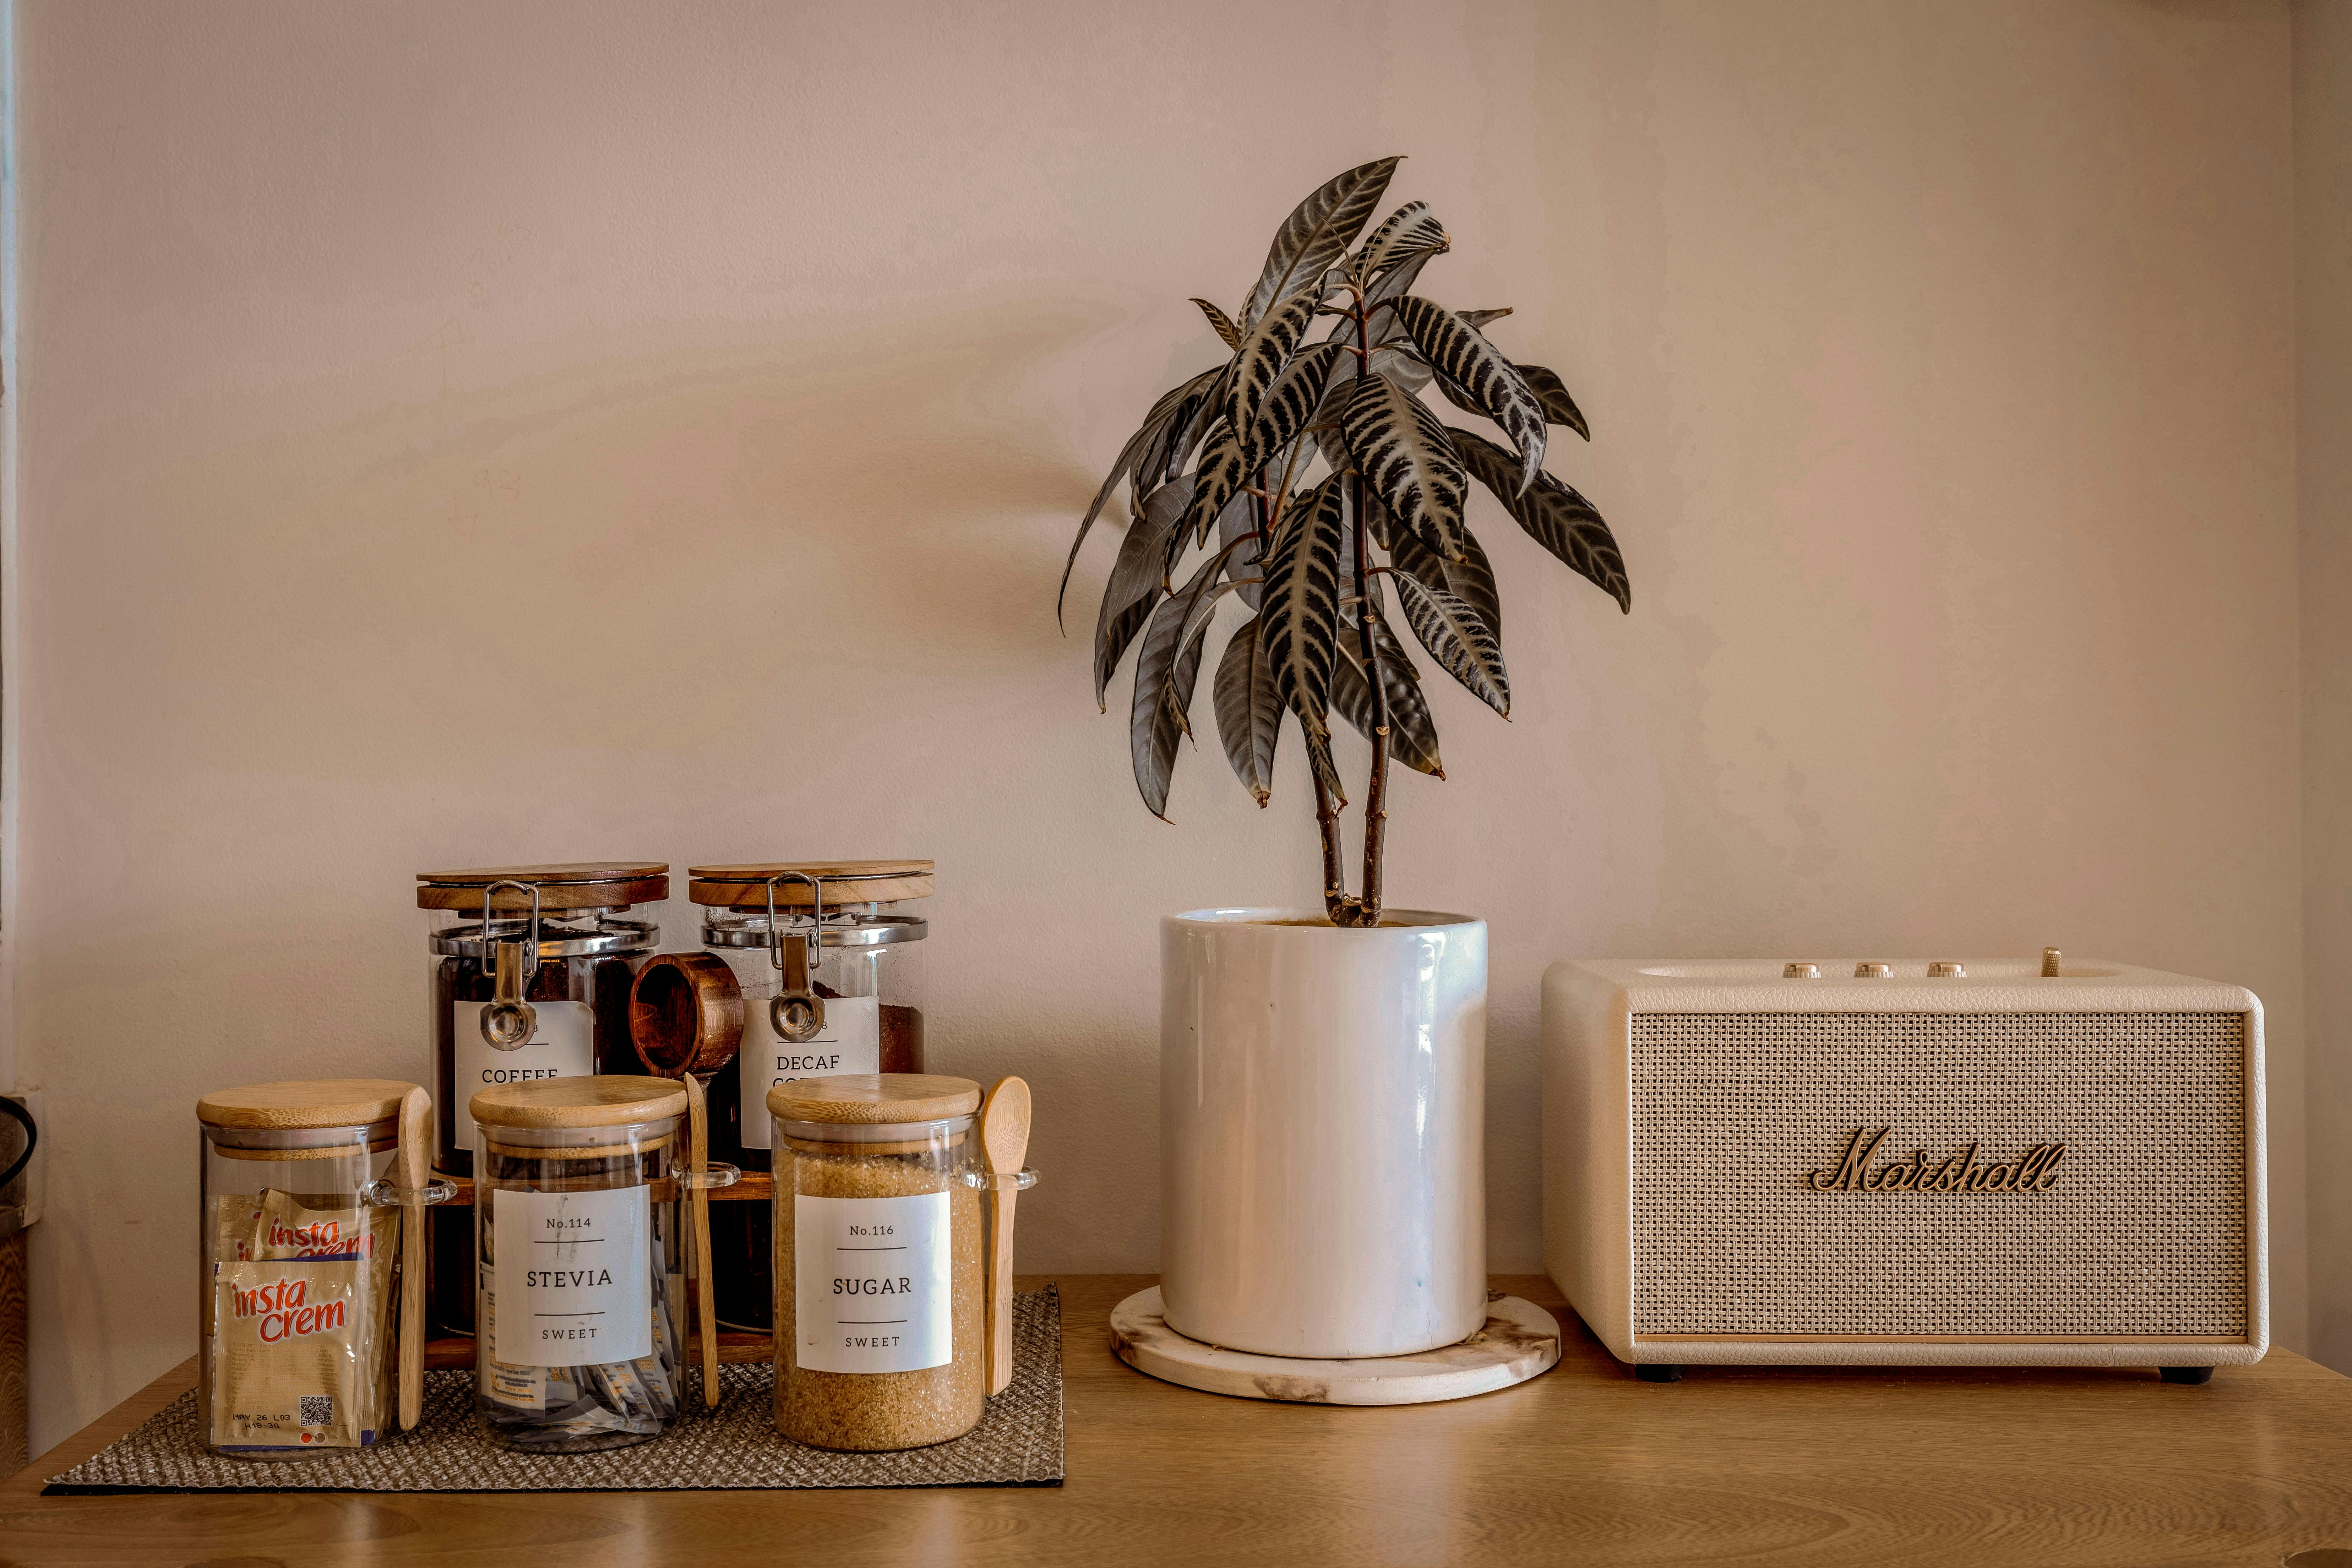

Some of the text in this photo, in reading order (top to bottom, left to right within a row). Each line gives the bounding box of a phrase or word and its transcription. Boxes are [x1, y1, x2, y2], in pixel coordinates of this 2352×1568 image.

[777, 1055, 839, 1070] DECAF
[1811, 1126, 2068, 1193] Marshall
[268, 1217, 339, 1247] insta
[546, 1218, 591, 1229] No.114
[850, 1226, 894, 1236] No.116
[527, 1269, 612, 1287] STEVIA
[833, 1277, 911, 1295] SUGAR
[232, 1278, 306, 1318] insta
[260, 1301, 344, 1343] crem
[542, 1328, 597, 1340] SWEET
[845, 1336, 900, 1347] SWEET
